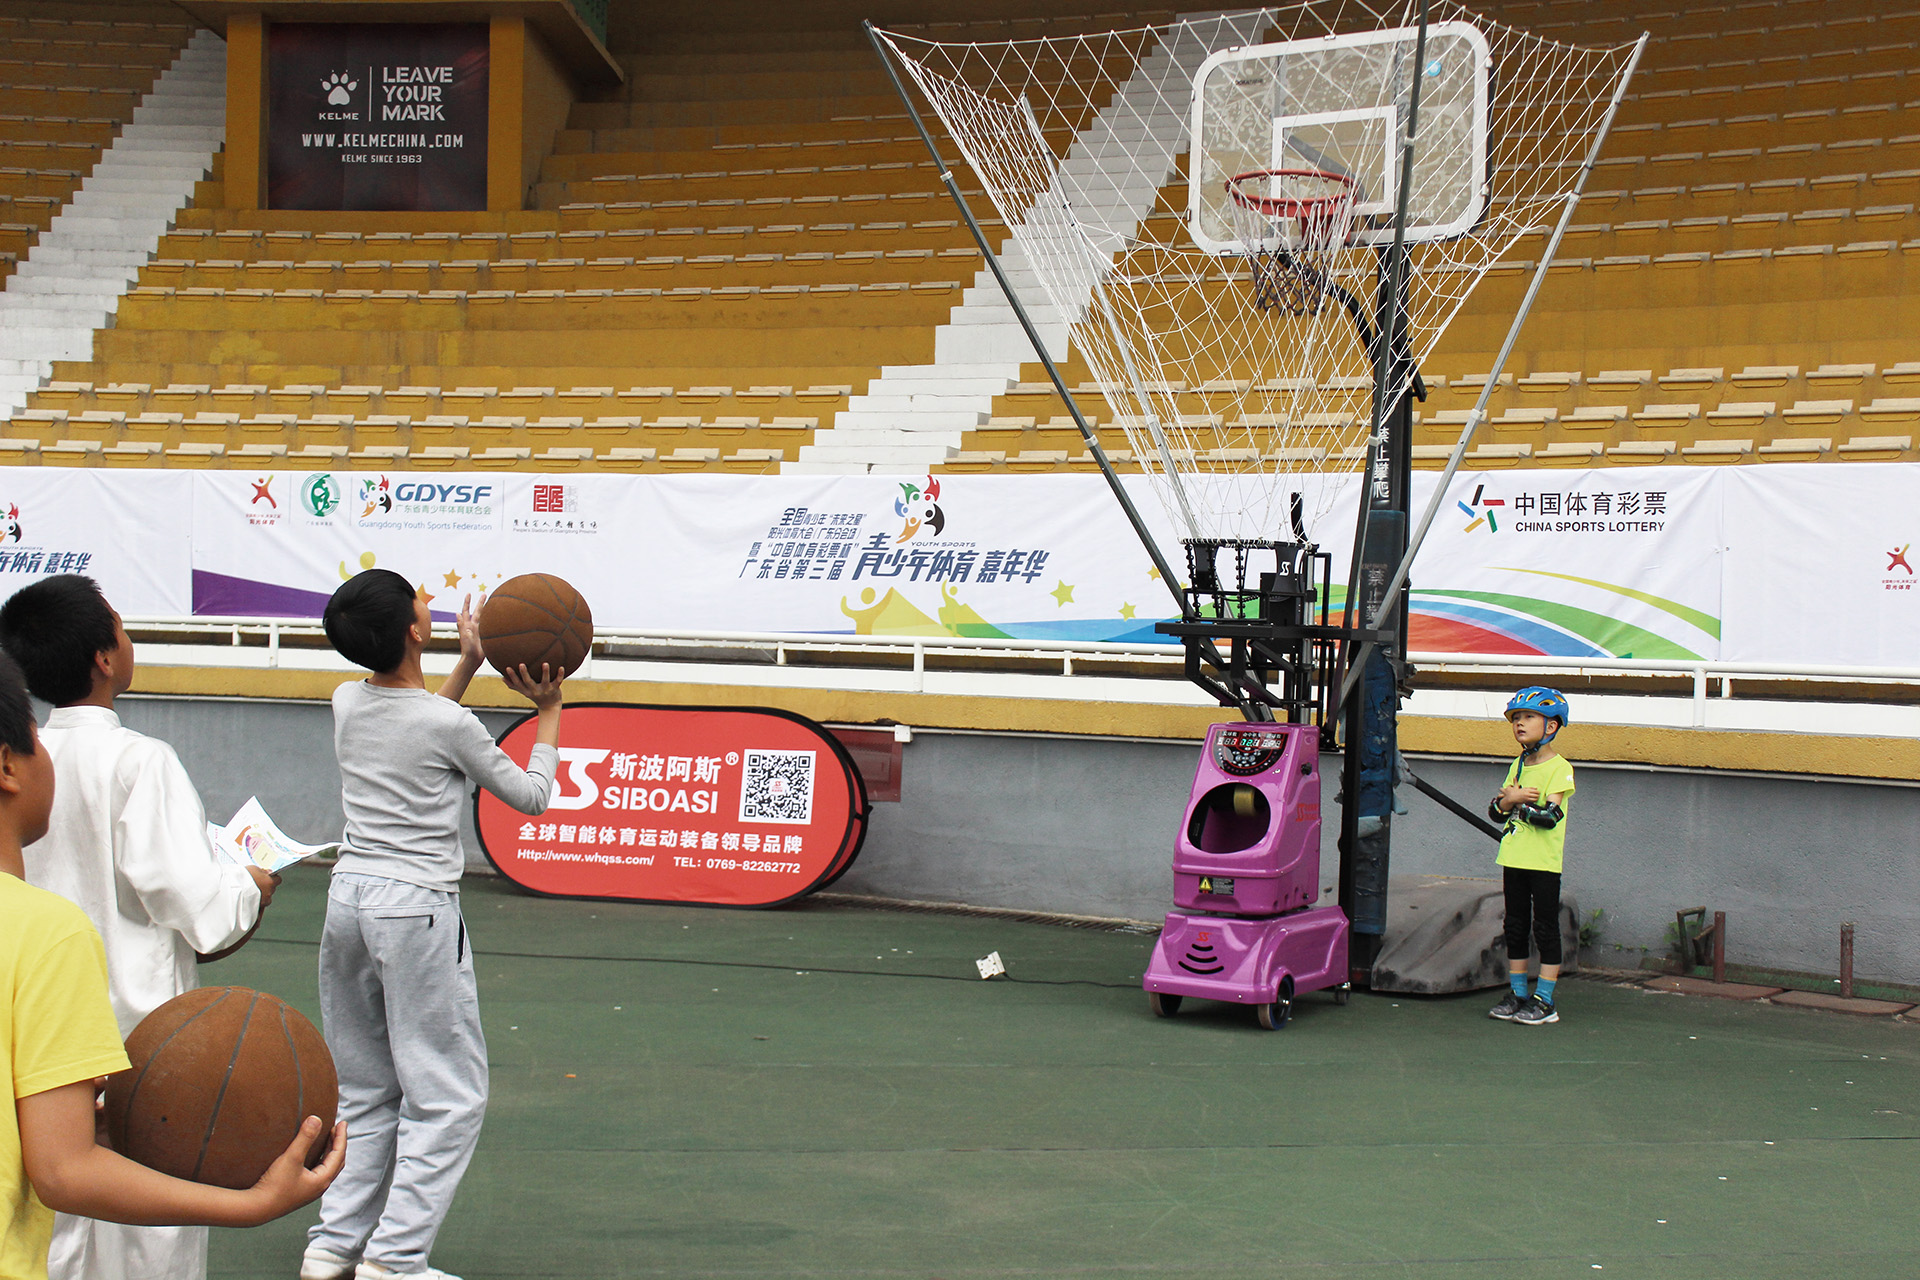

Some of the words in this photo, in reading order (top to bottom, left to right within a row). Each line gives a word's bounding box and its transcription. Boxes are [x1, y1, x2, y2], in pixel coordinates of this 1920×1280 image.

[382, 66, 453, 83] LEAVE
[382, 85, 442, 102] YOUR
[318, 112, 359, 121] KELME
[382, 105, 445, 121] MARK
[302, 133, 463, 149] WWW.KELMECHINA.COM
[341, 154, 367, 163] KELME
[370, 154, 394, 164] SINCE
[396, 154, 422, 164] 1963
[395, 483, 493, 504] GDYSF
[395, 504, 493, 515] 广东省青少年体育联合会
[1515, 491, 1667, 517] 中国体育彩票
[358, 520, 403, 531] Guangdong
[404, 521, 426, 530] Youth
[427, 521, 451, 531] Sports
[453, 522, 493, 531] Federation
[1515, 522, 1552, 532] CHINA
[1555, 521, 1605, 532] SPORTS
[1608, 521, 1665, 532] LOTTERY
[739, 558, 846, 581] 广东省第三届
[602, 786, 719, 814] SIBOASI
[518, 822, 803, 854] 全球智能体育运动装备领导品牌
[517, 848, 655, 866] Http://www.whqss.com/
[706, 858, 801, 874] 0769-82262772
